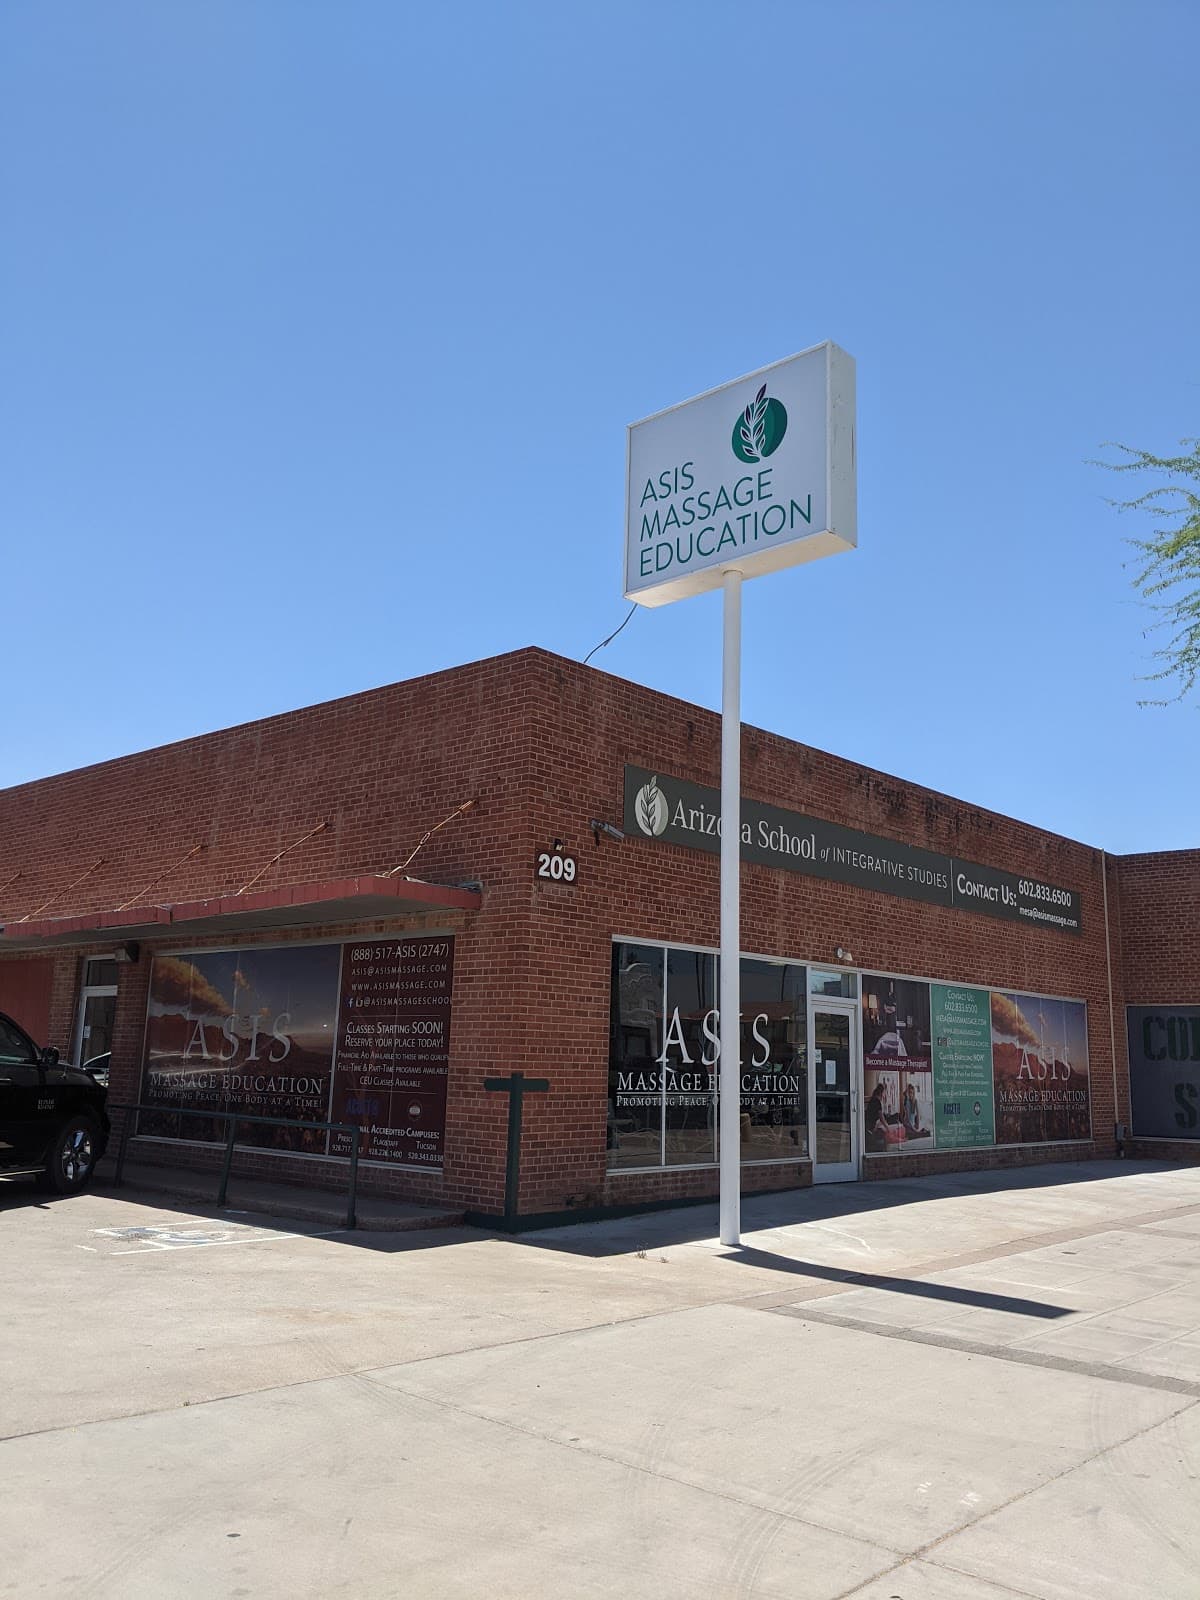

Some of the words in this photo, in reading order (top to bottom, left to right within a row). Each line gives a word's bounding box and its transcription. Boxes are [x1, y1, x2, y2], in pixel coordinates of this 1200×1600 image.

[640, 462, 695, 508] ASIS
[640, 468, 773, 543] MASSAGE
[640, 494, 811, 577] EDUCATION
[671, 799, 752, 845] Ariza
[758, 820, 817, 860] School
[820, 847, 831, 863] of
[833, 847, 905, 879] INTEGRATIVE
[907, 866, 948, 889] STUDIES
[538, 853, 576, 881] 209
[957, 873, 999, 902] CONTACT
[1001, 884, 1017, 907] US:
[1018, 879, 1072, 907] 602.833.6500
[1019, 906, 1078, 928] mesa@asismassage.com
[351, 947, 373, 962] (888)
[375, 945, 416, 960] 517-ASIS
[419, 943, 449, 958] (2747)
[351, 964, 447, 976] ASIS@ASISMASSAGE.COM
[351, 980, 446, 991] WWW.ASISMASSAGE.COM
[346, 1021, 375, 1034] CLASSES
[377, 1022, 410, 1034] STARTING
[412, 1021, 443, 1034] SOON!
[655, 1006, 771, 1067] ASS
[180, 1013, 292, 1063] ASIS
[345, 1035, 373, 1047] RESERVE
[374, 1038, 393, 1047] YOUR
[394, 1038, 416, 1048] PLACE
[418, 1036, 444, 1048] TODAY!
[866, 1056, 884, 1066] Become
[888, 1057, 907, 1069] Massage
[1016, 1046, 1071, 1081] ASIS
[149, 1072, 217, 1090] MASSAGE
[222, 1075, 323, 1095] EDUCATION
[360, 1076, 372, 1085] CEU
[395, 1078, 421, 1088] AVAILABLE
[617, 1072, 702, 1092] MASSAGE
[708, 1073, 800, 1092] ECATION
[245, 1094, 268, 1106] BODY
[294, 1095, 323, 1108] TIME!
[616, 1095, 674, 1107] PROMOTING
[778, 1095, 800, 1106] TIME!
[1000, 1090, 1039, 1103] MASSAGE
[1041, 1090, 1086, 1103] EDUCATION
[371, 1124, 405, 1137] ACCREDITED
[406, 1127, 440, 1140] CAMPUSES:
[415, 1140, 438, 1151] TUCSON
